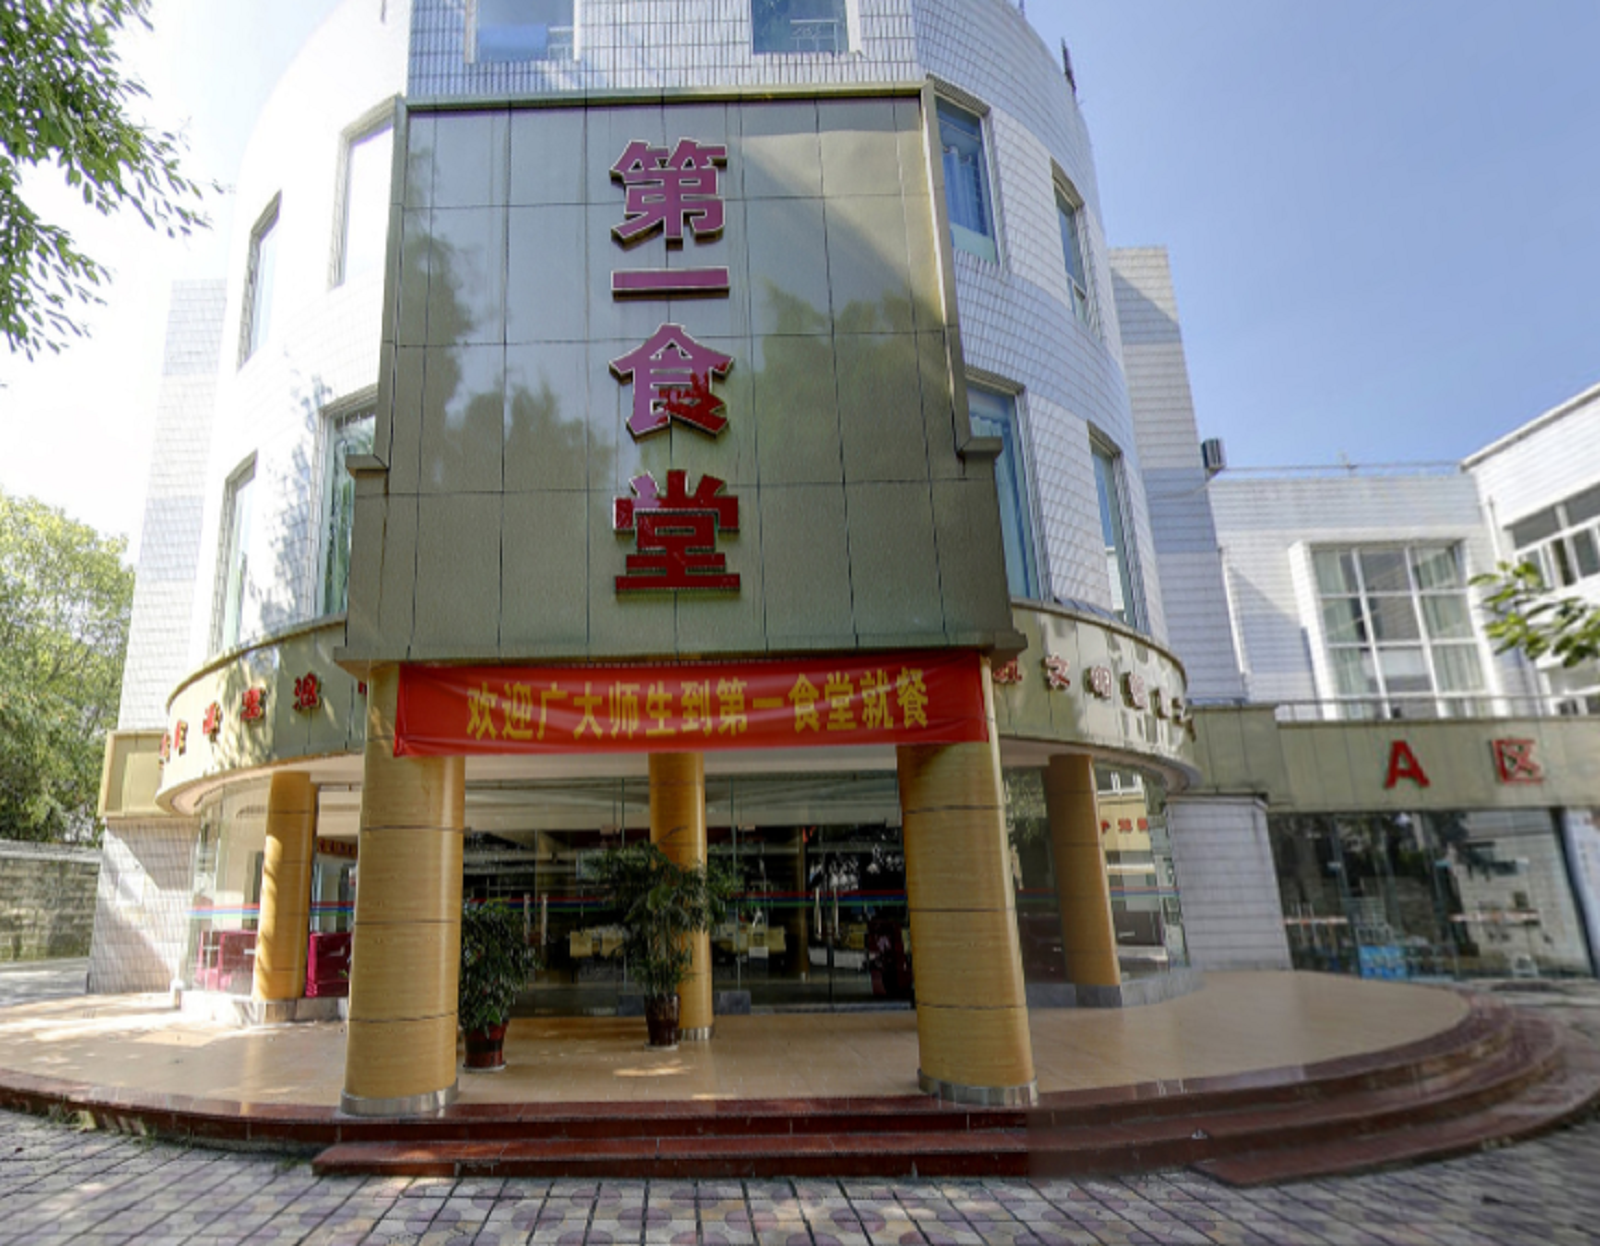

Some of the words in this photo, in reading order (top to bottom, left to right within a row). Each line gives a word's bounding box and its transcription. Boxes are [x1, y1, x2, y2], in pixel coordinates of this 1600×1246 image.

[609, 137, 740, 596] 第一食堂
[466, 666, 929, 742] 欢迎广大师生到第一食堂就餐
[1384, 739, 1431, 789] A
[1490, 737, 1545, 784] 区
